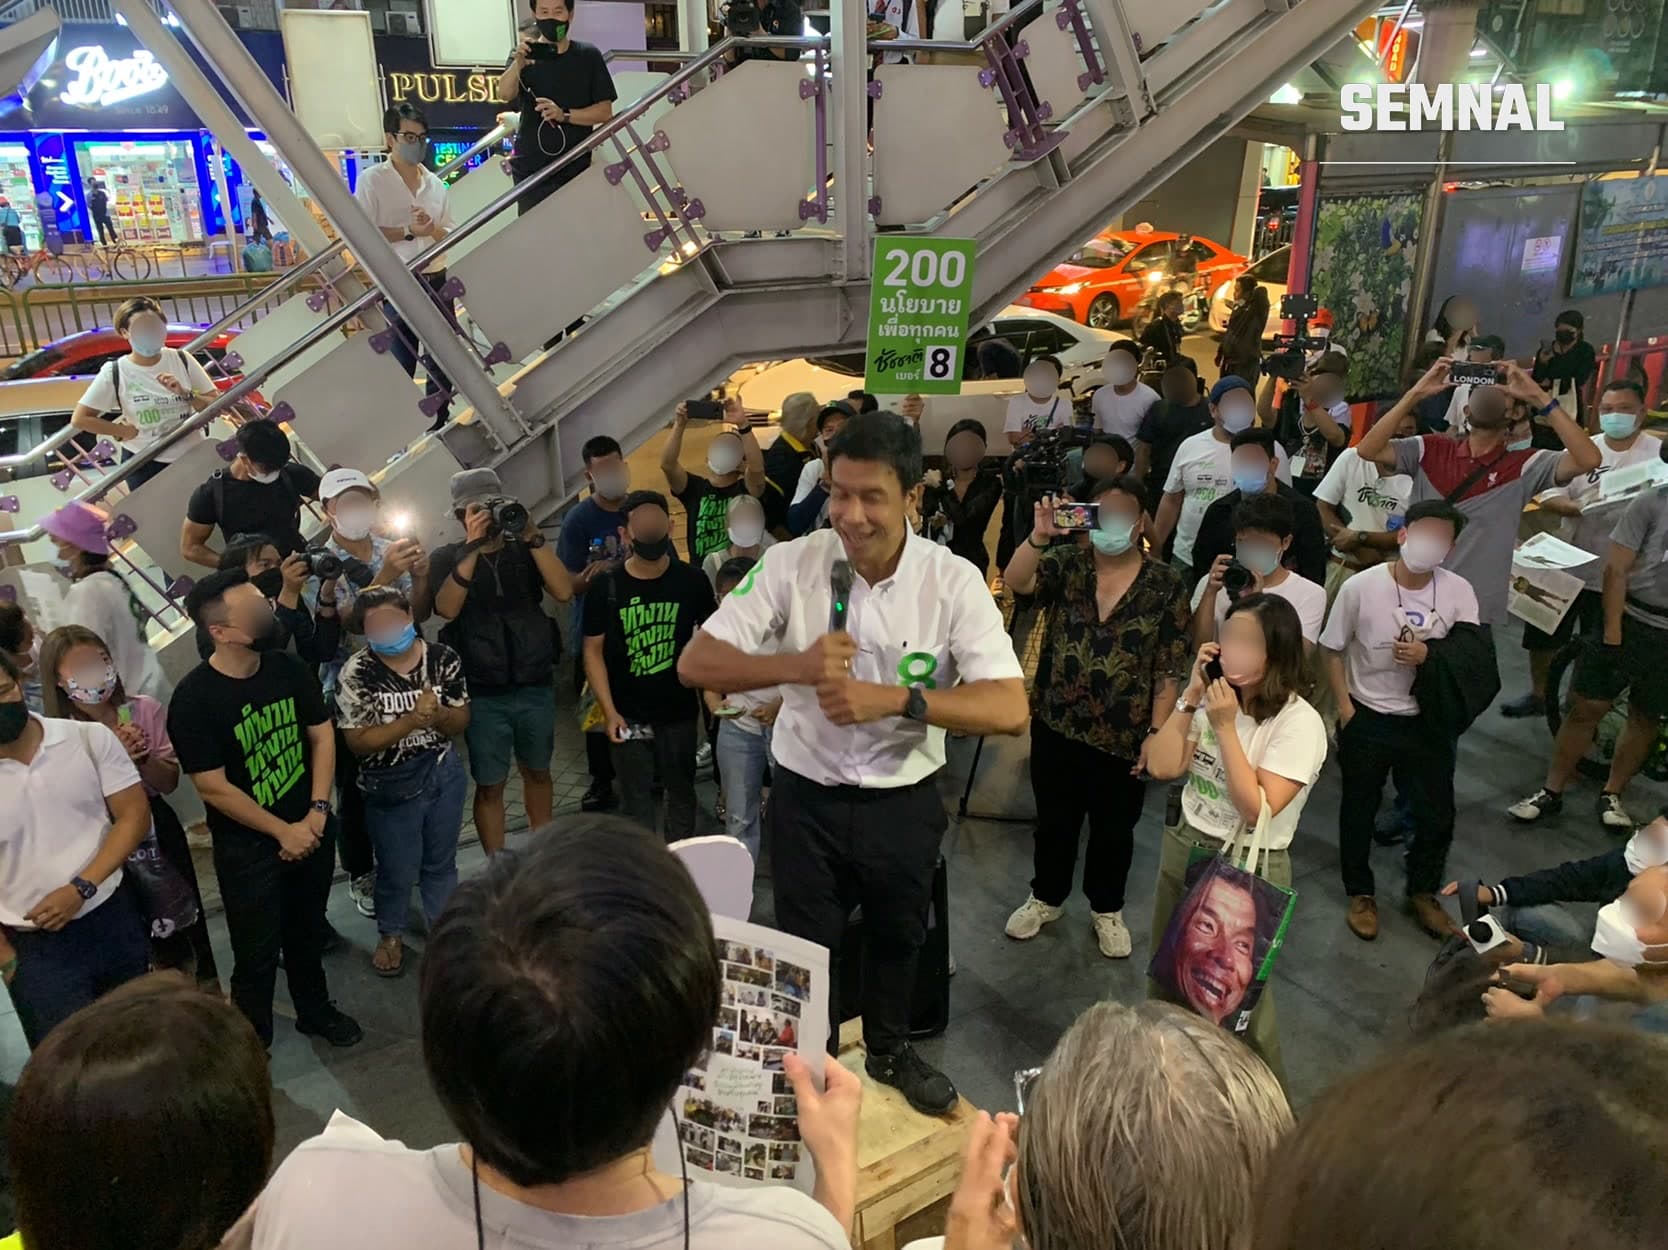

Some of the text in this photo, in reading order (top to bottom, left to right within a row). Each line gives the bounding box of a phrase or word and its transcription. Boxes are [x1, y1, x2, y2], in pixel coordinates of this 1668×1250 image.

[883, 249, 967, 288] 200
[880, 289, 962, 315] นโยบาย
[878, 313, 960, 344] เพื่อทุกคน
[873, 348, 924, 373] ชัชชาติ
[895, 347, 951, 381] เบอร์ 8
[1453, 375, 1495, 385] LONDON
[619, 596, 680, 636] ทำงาน
[233, 697, 298, 756] ทำงาน
